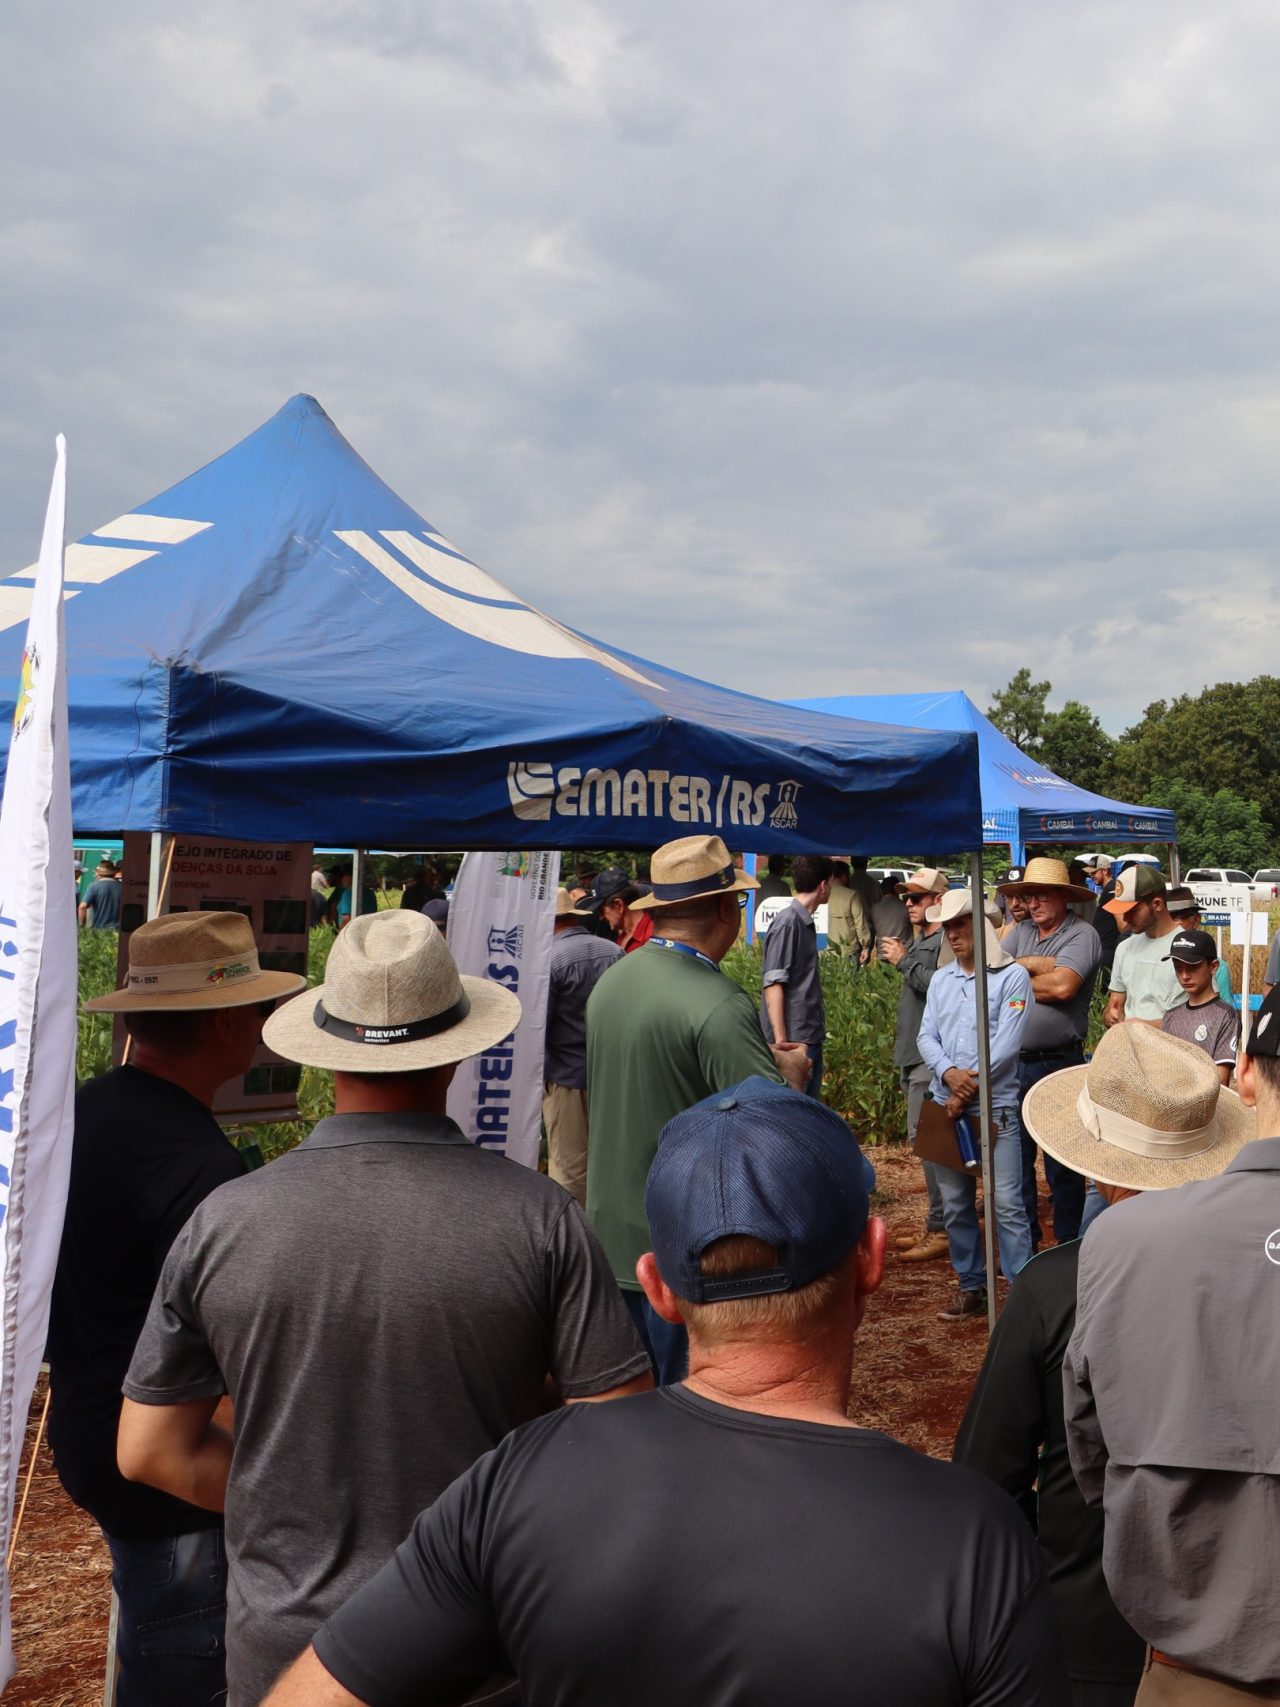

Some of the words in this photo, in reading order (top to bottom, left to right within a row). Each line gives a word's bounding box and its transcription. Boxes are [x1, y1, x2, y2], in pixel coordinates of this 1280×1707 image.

[770, 818, 798, 829] ASCAR
[203, 847, 273, 861] INTEGRADO
[275, 850, 293, 862] DE
[226, 863, 243, 875] DA
[245, 864, 278, 877] SOJA
[540, 852, 549, 885] GRANDE
[537, 886, 545, 900] RIO
